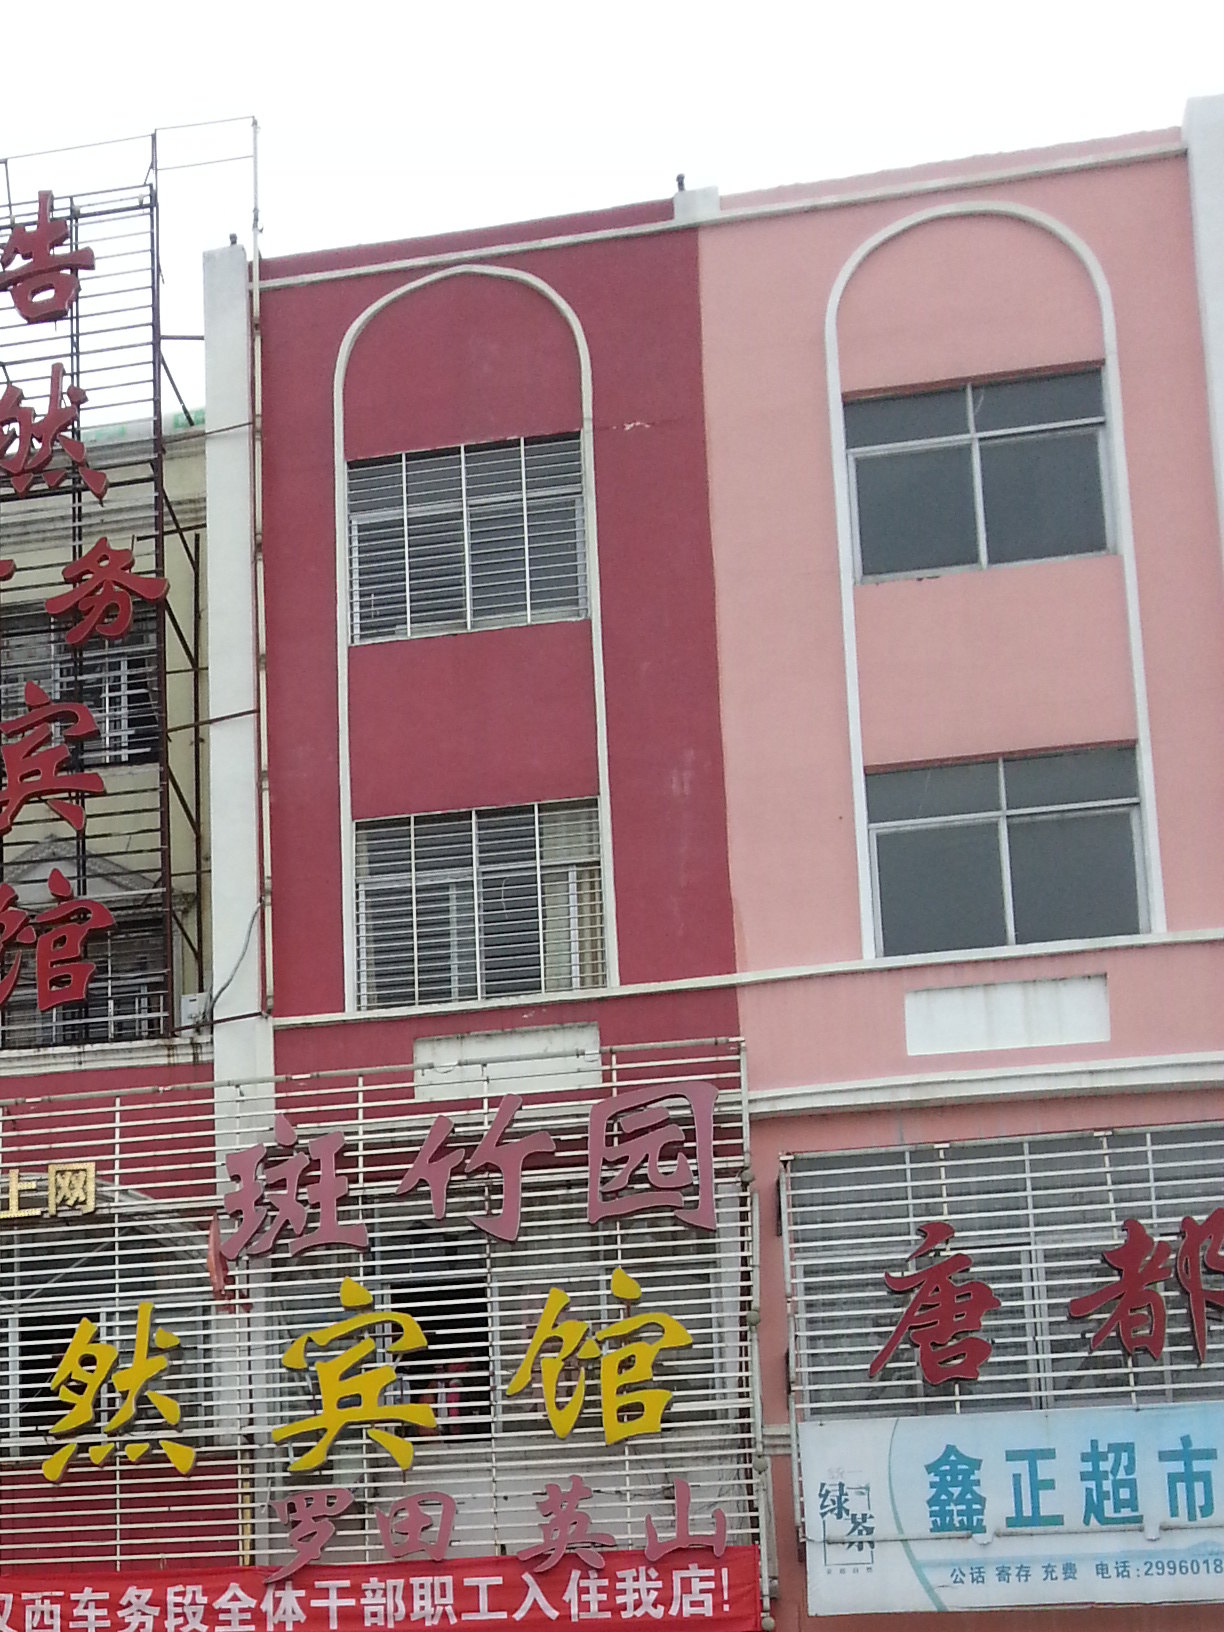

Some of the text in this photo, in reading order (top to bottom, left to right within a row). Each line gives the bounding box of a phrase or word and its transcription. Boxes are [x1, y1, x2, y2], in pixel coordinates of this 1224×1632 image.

[220, 1081, 719, 1263] 斑竹园
[818, 1481, 876, 1552] 绿茶
[924, 1433, 1218, 1534] 鑫正超市
[950, 1566, 986, 1585] 公话
[995, 1563, 1032, 1584] 寄存
[1041, 1561, 1078, 1582] 充费
